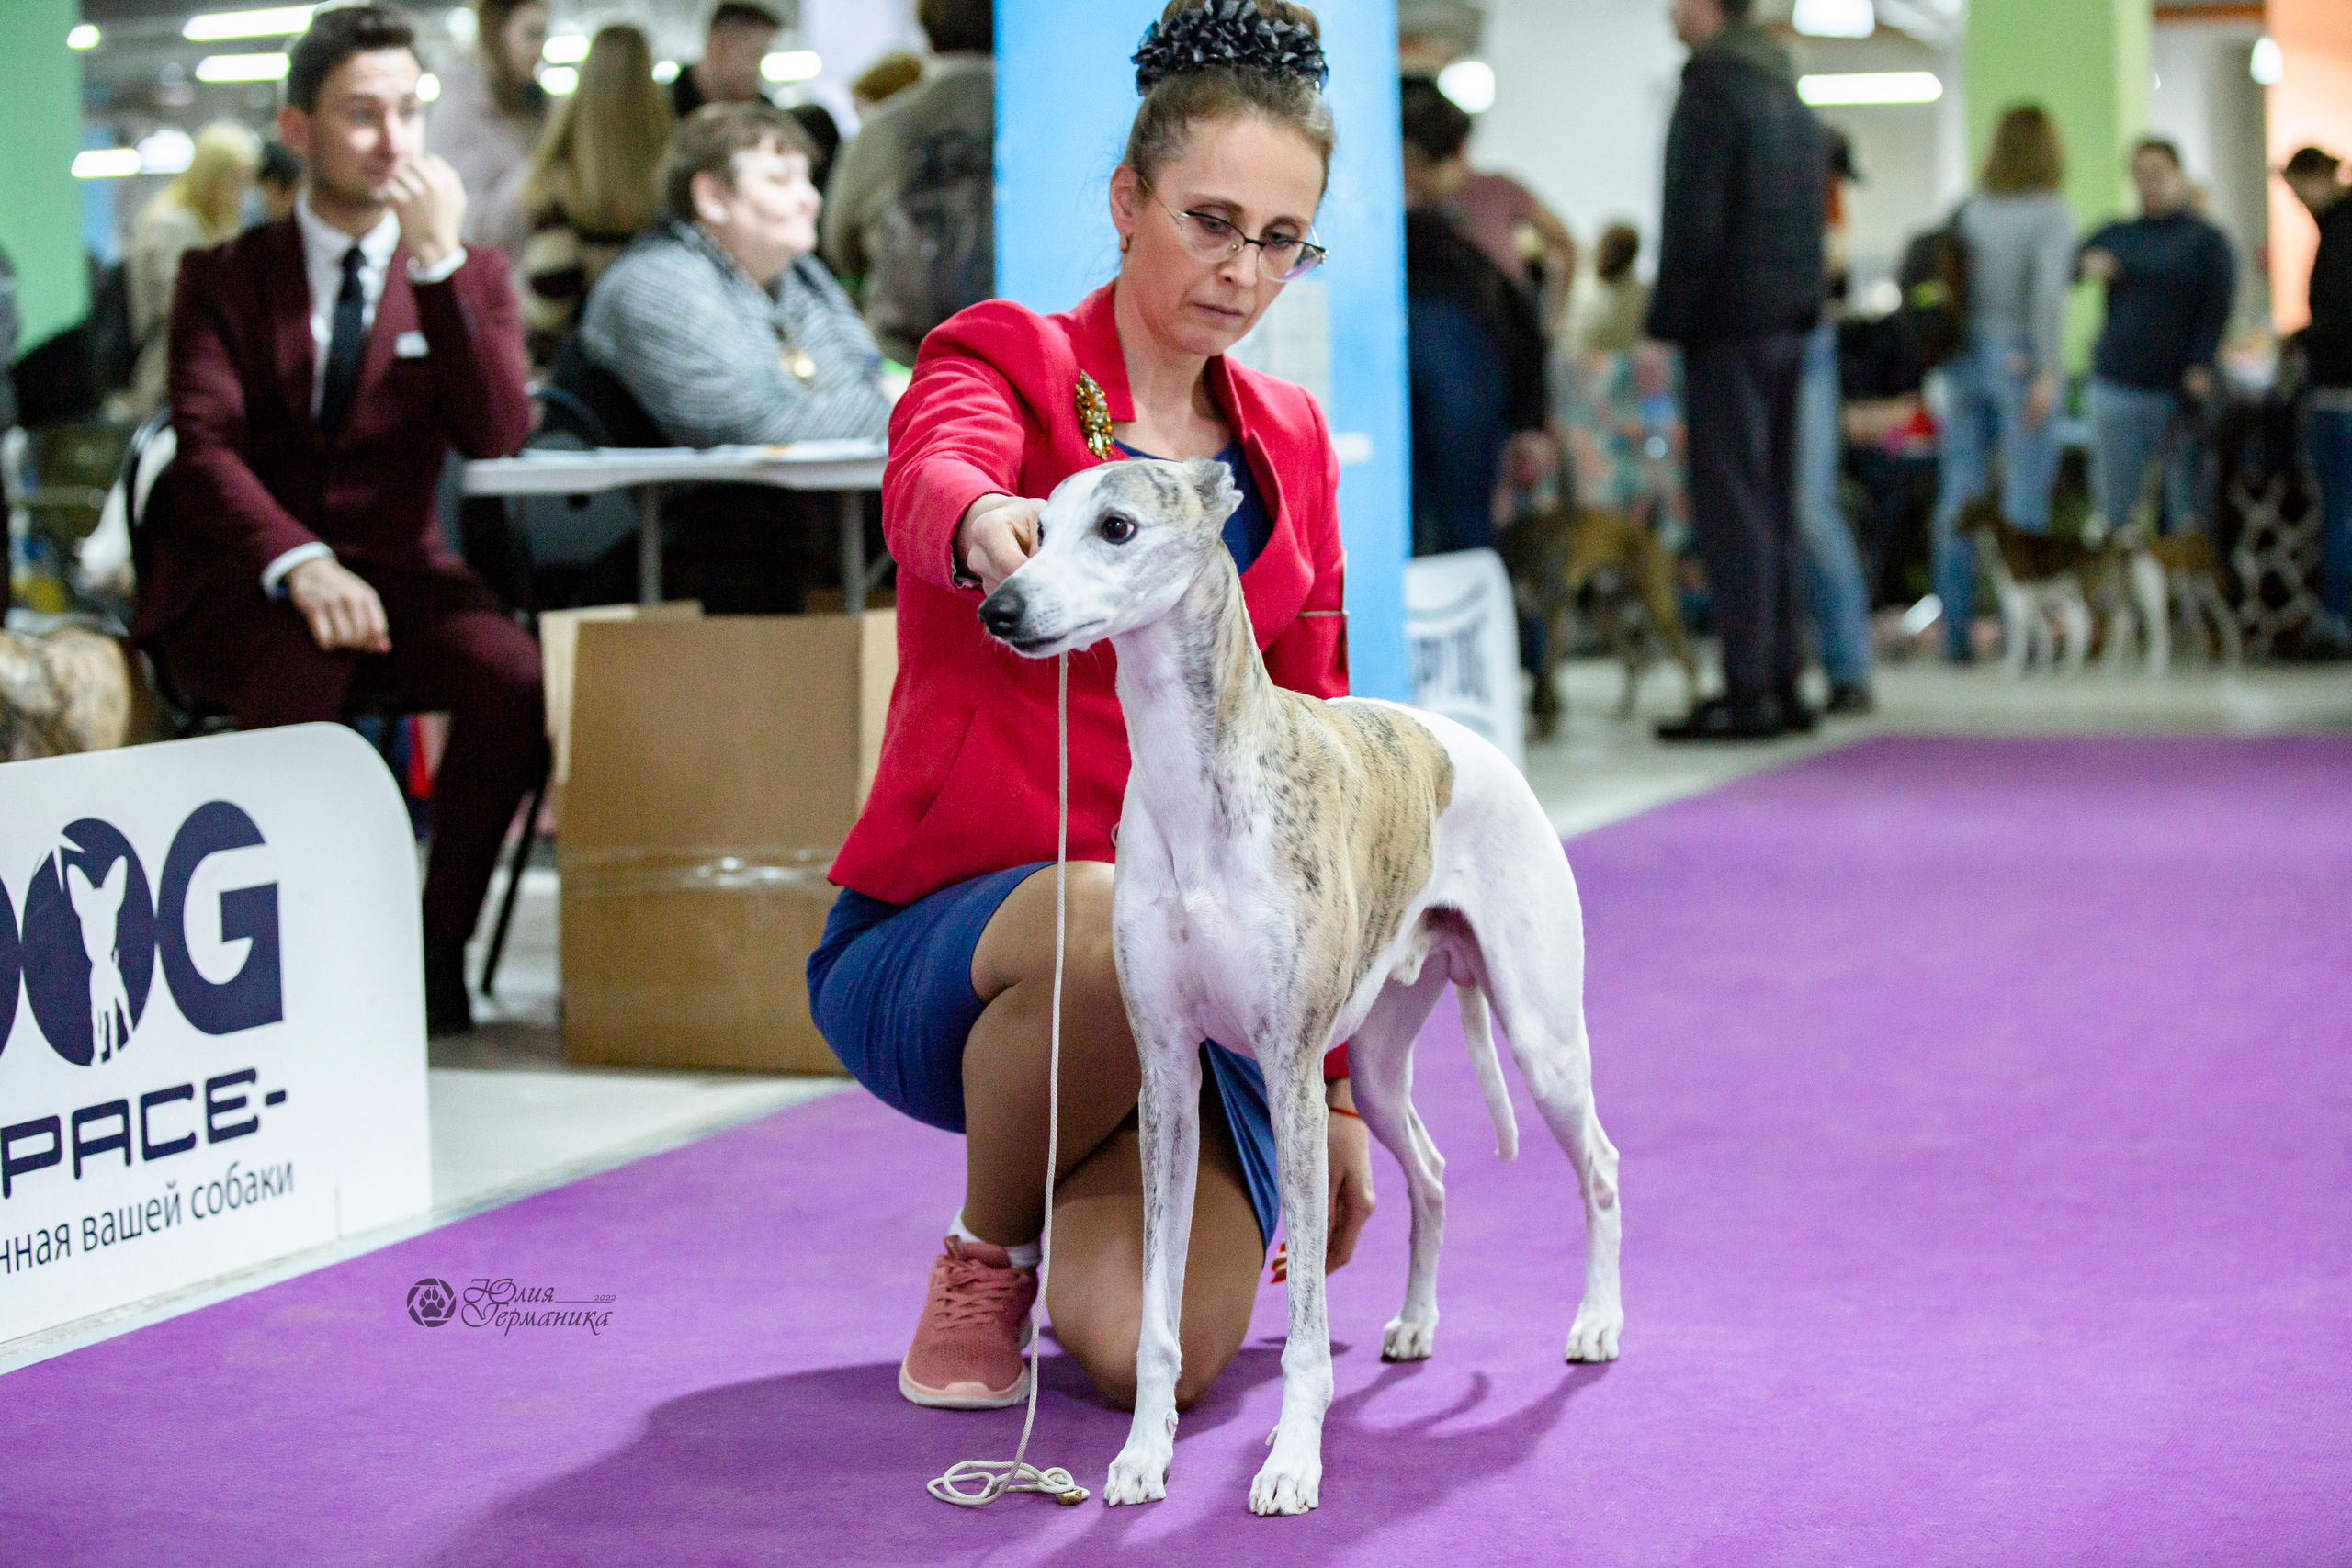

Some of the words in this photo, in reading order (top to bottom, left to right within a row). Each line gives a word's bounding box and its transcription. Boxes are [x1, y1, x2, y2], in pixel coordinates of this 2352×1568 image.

[0, 800, 284, 1066] OG
[82, 1179, 182, 1252] вашей
[191, 1161, 293, 1220] собаки
